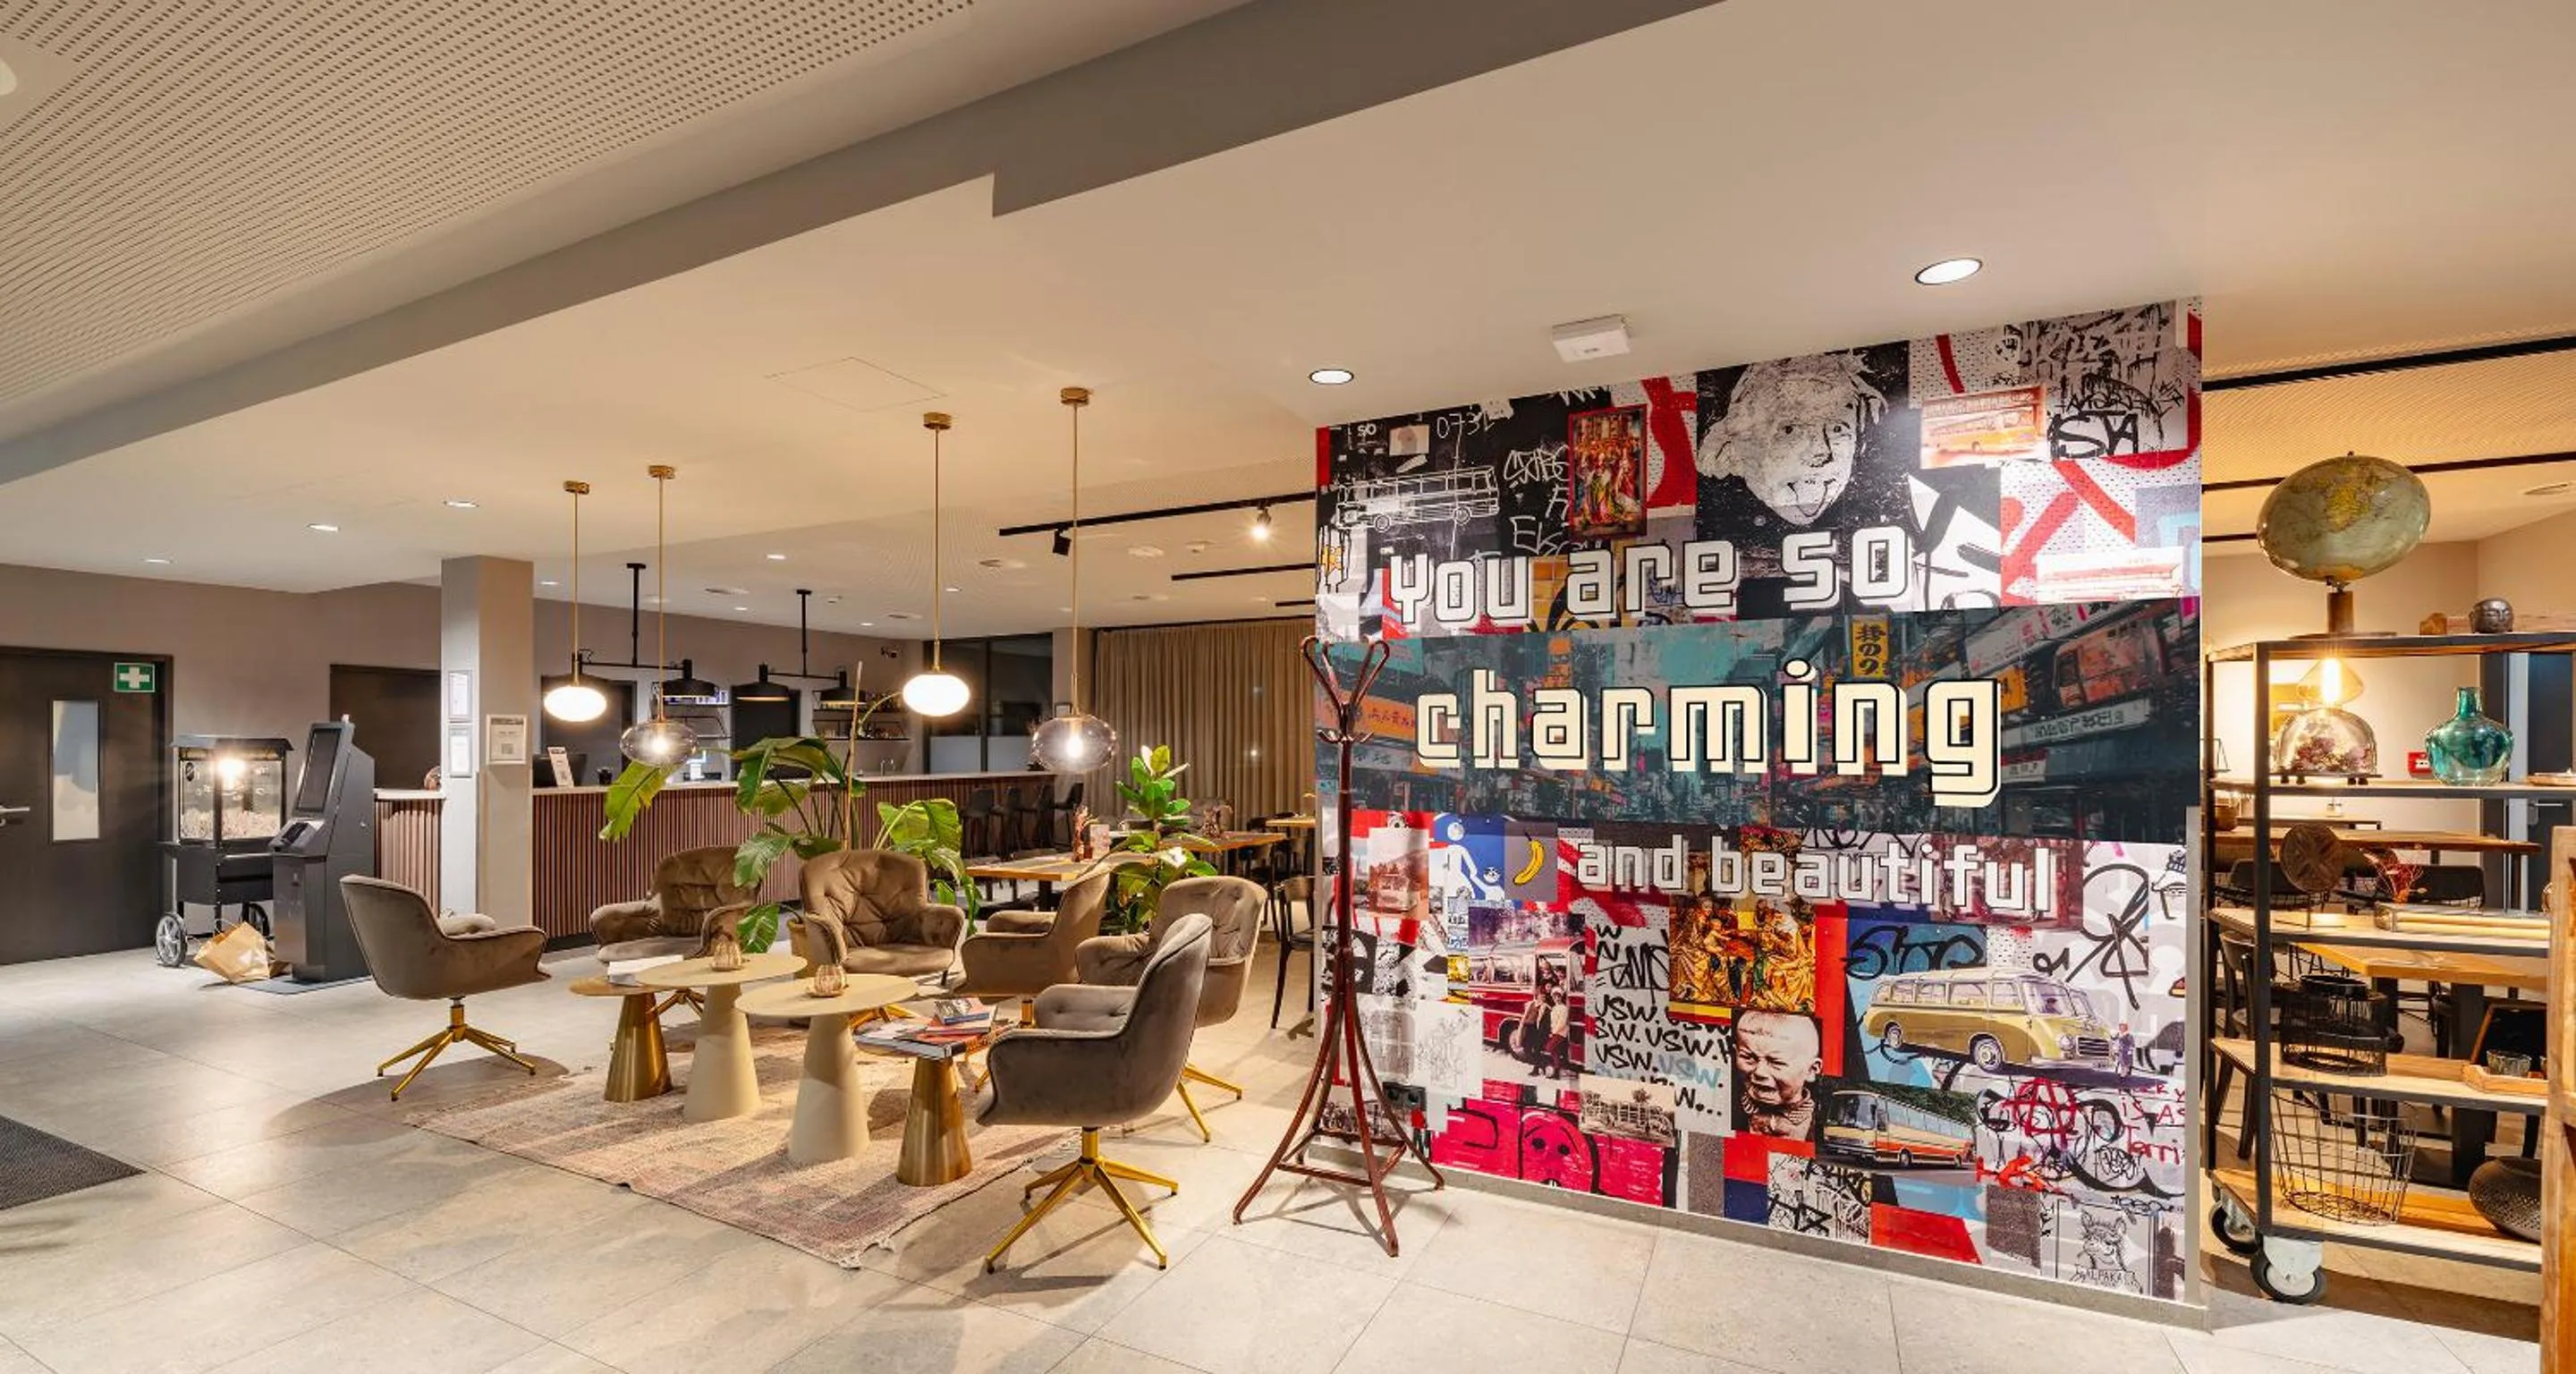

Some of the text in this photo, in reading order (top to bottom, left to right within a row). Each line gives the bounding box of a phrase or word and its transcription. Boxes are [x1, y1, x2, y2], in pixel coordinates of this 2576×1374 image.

[1389, 552, 1531, 630] You
[1566, 539, 1737, 619] are
[1417, 657, 2001, 807] charming
[1578, 834, 2056, 917] and beautiful
